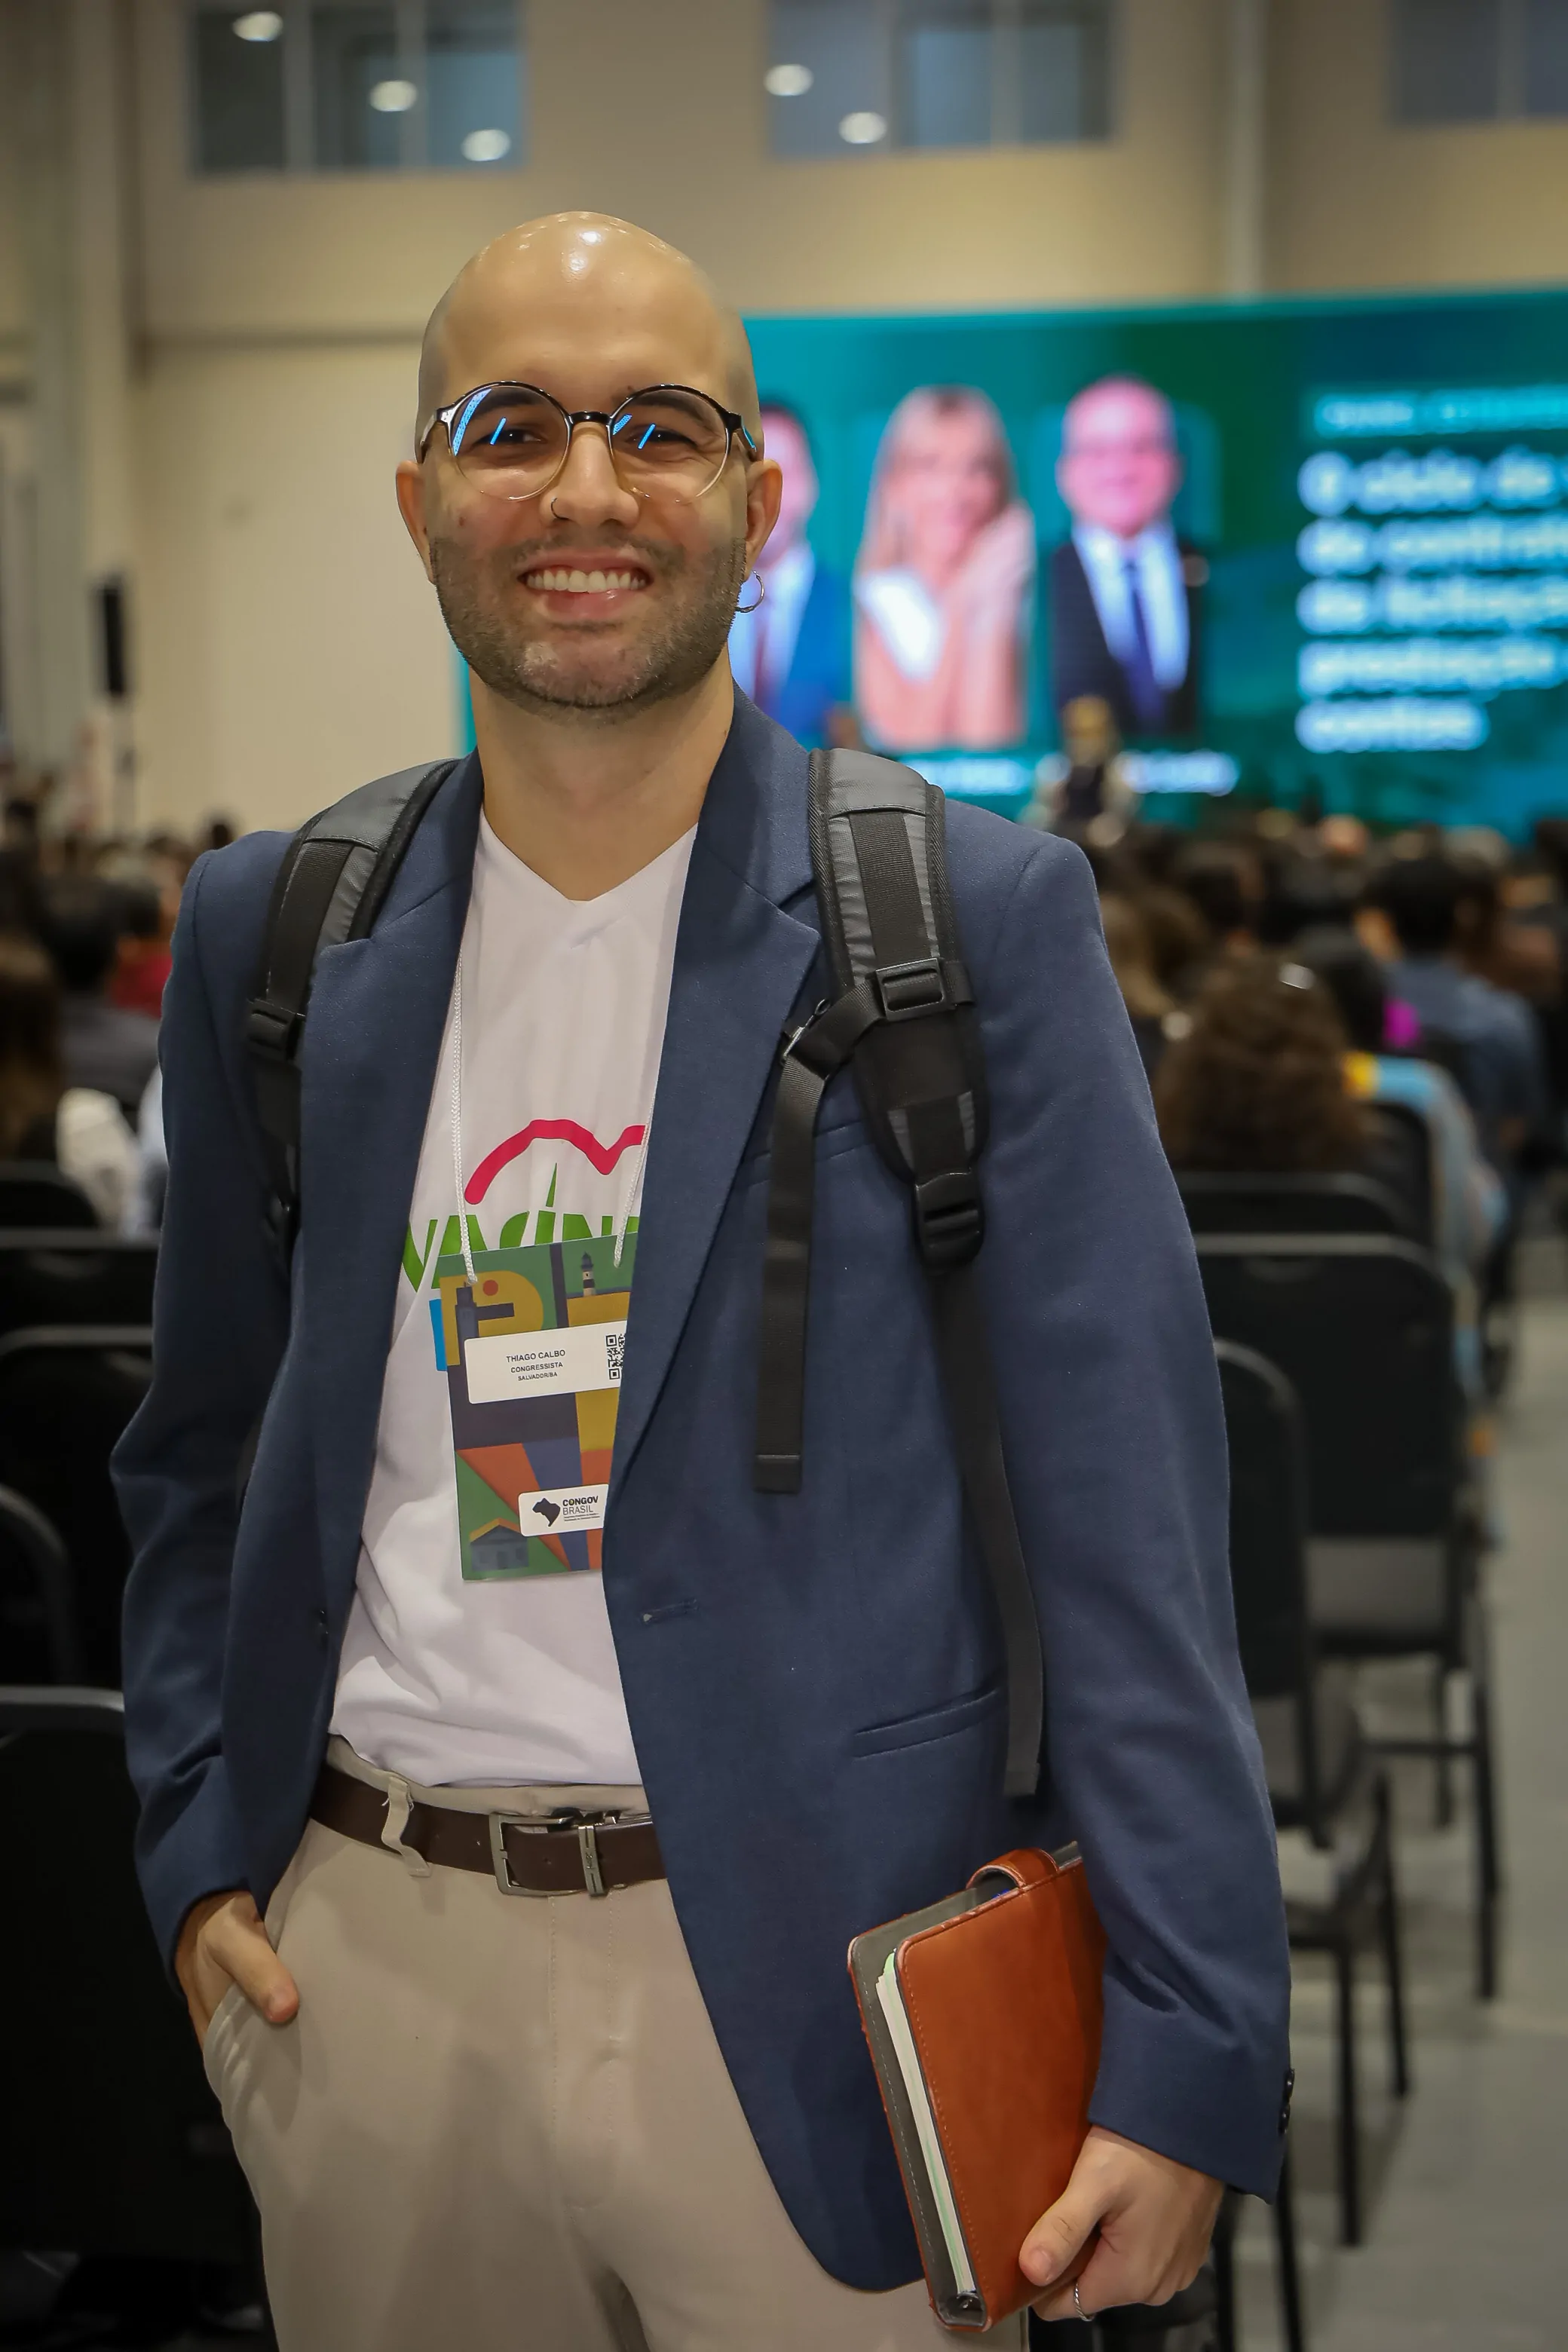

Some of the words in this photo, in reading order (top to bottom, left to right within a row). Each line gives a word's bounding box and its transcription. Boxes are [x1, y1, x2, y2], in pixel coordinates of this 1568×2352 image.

[506, 1353, 536, 1362] THIAGO
[538, 1349, 565, 1358] CALBO
[510, 1362, 563, 1373] CONGRESSISTA
[562, 1496, 599, 1506] CONGOV
[563, 1505, 593, 1514] BRASIL
